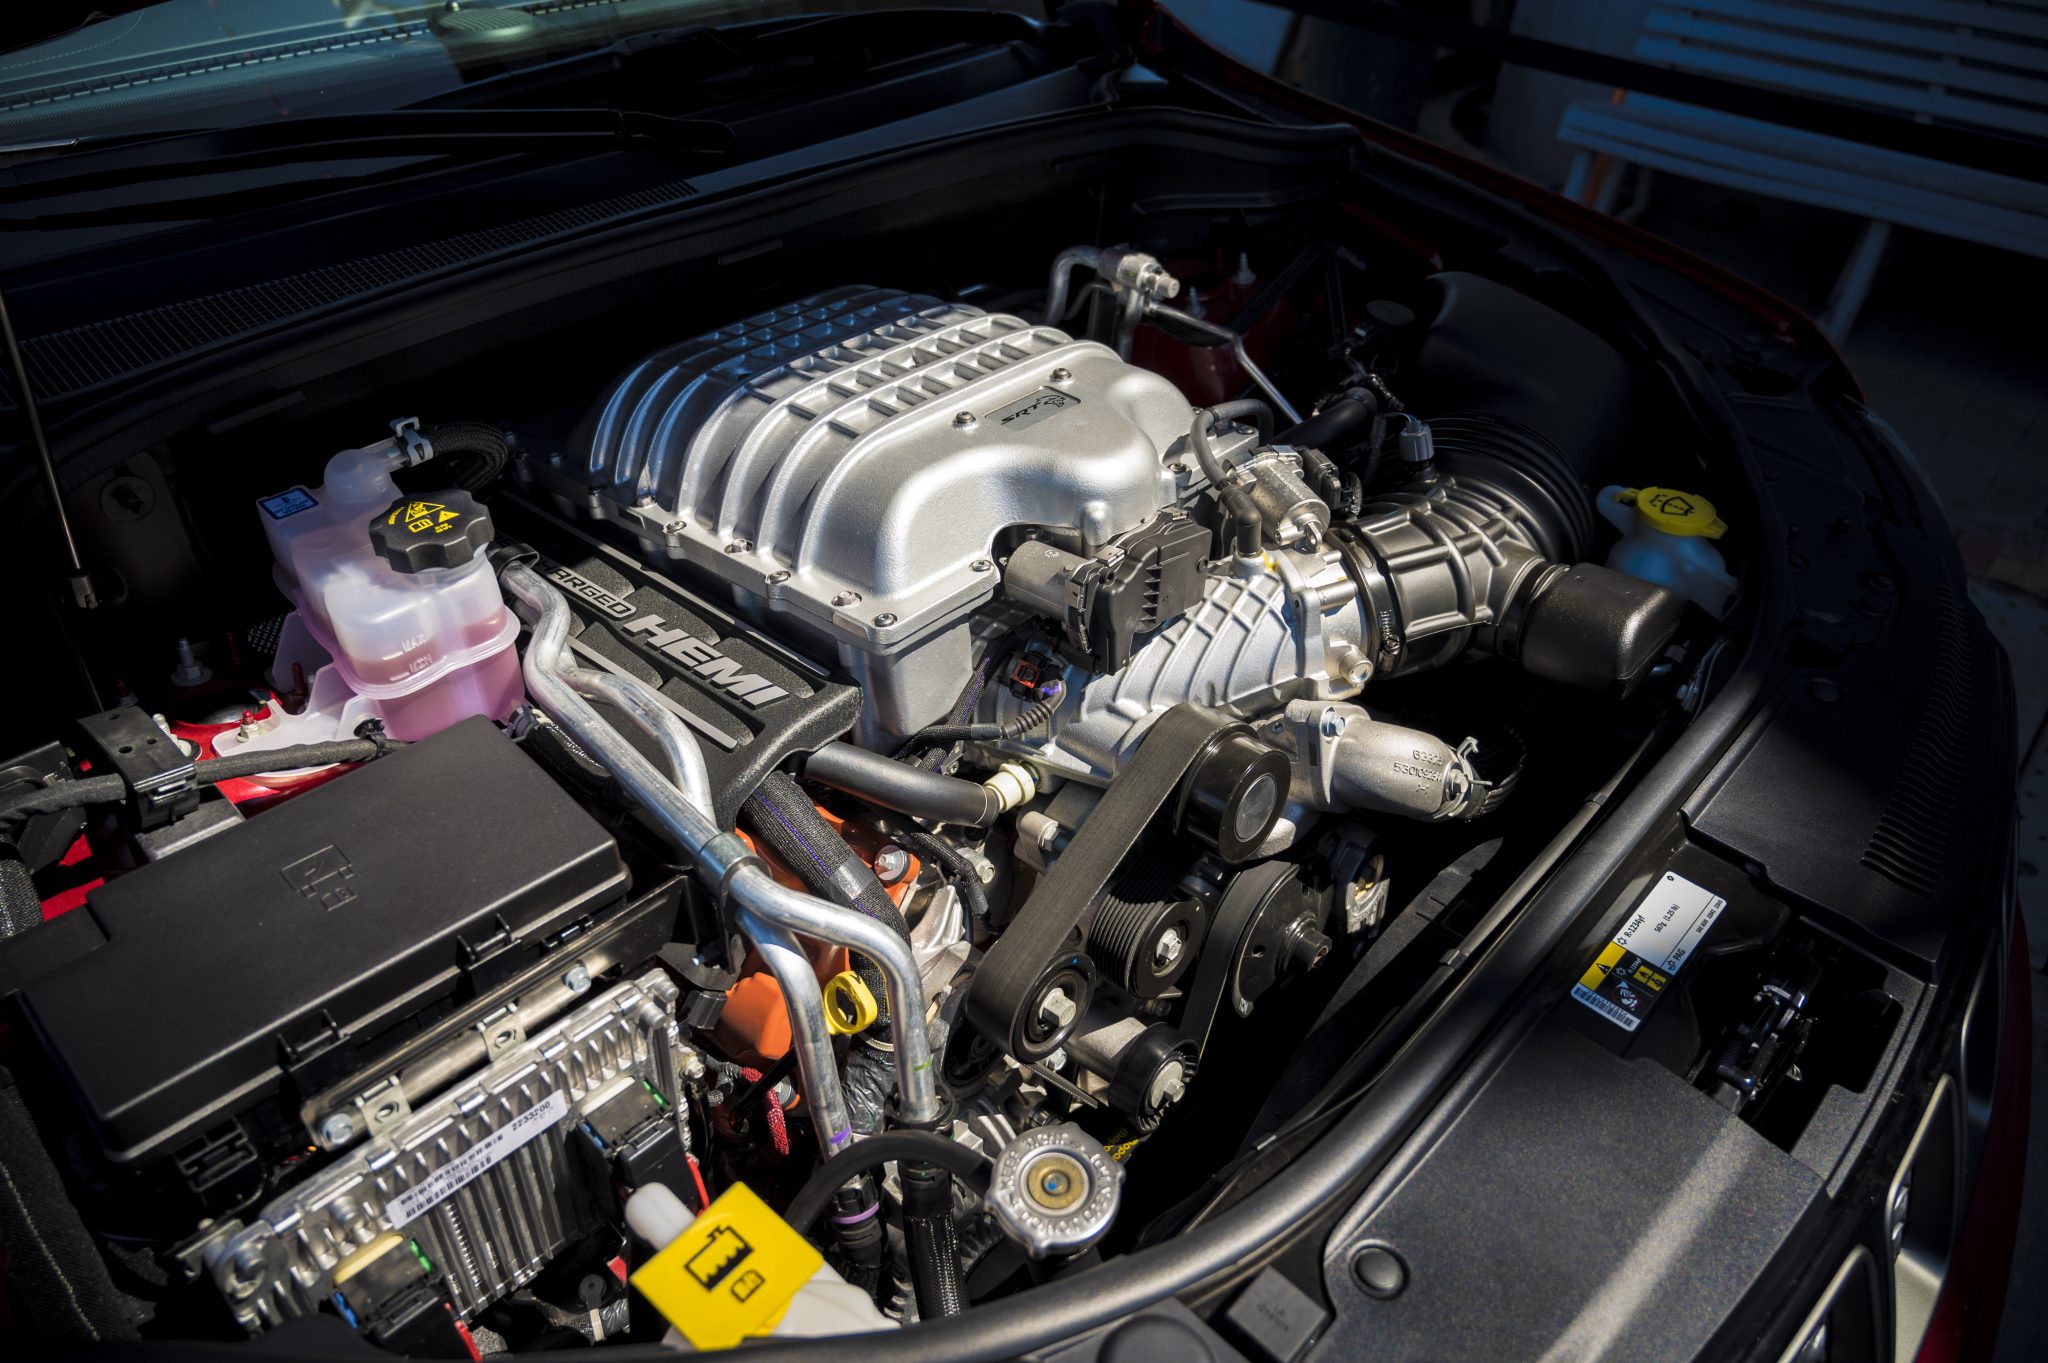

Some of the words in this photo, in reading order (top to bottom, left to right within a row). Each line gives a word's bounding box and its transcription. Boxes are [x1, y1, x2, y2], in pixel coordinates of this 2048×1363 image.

[1001, 400, 1041, 425] SRT
[622, 614, 790, 709] HEMI
[1623, 914, 1645, 938] R-1234yf
[1672, 948, 1686, 961] PAG
